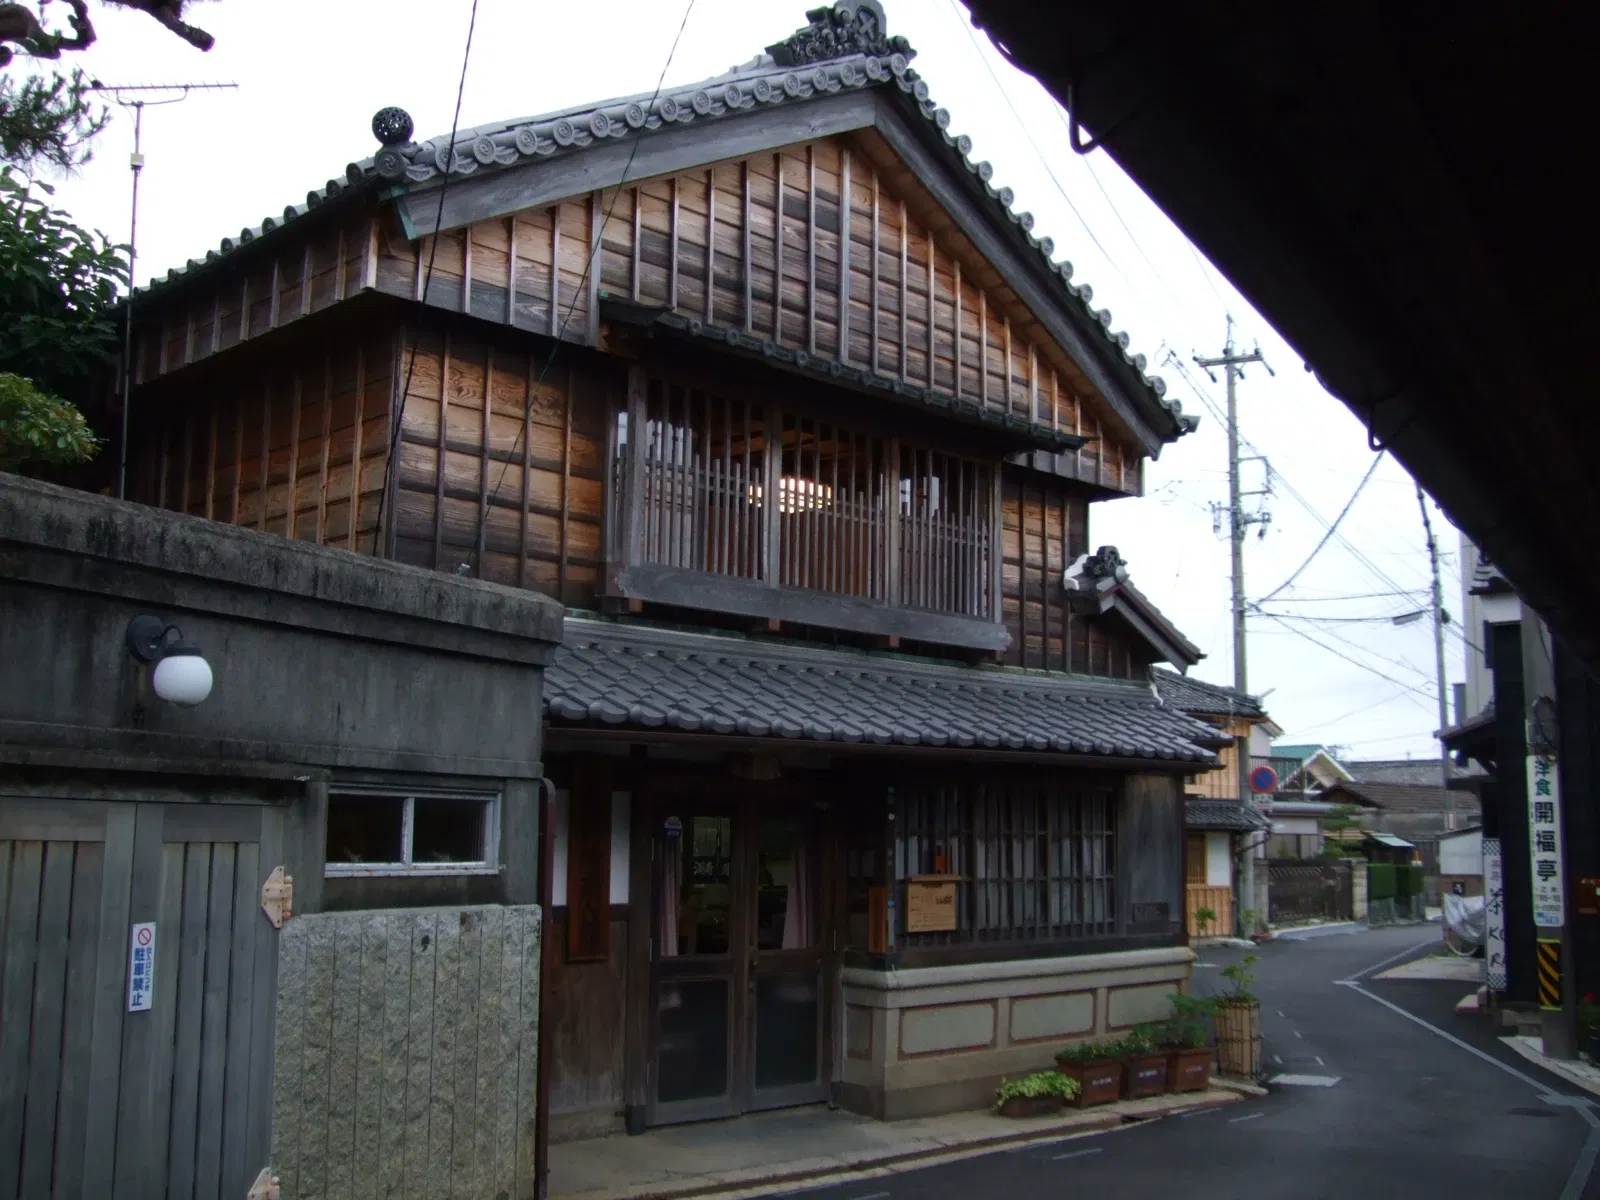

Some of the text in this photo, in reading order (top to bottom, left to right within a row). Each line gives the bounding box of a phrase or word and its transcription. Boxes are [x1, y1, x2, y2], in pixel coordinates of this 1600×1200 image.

[1535, 802, 1557, 882] 開福亭
[132, 947, 146, 1007] 駐車禁止
